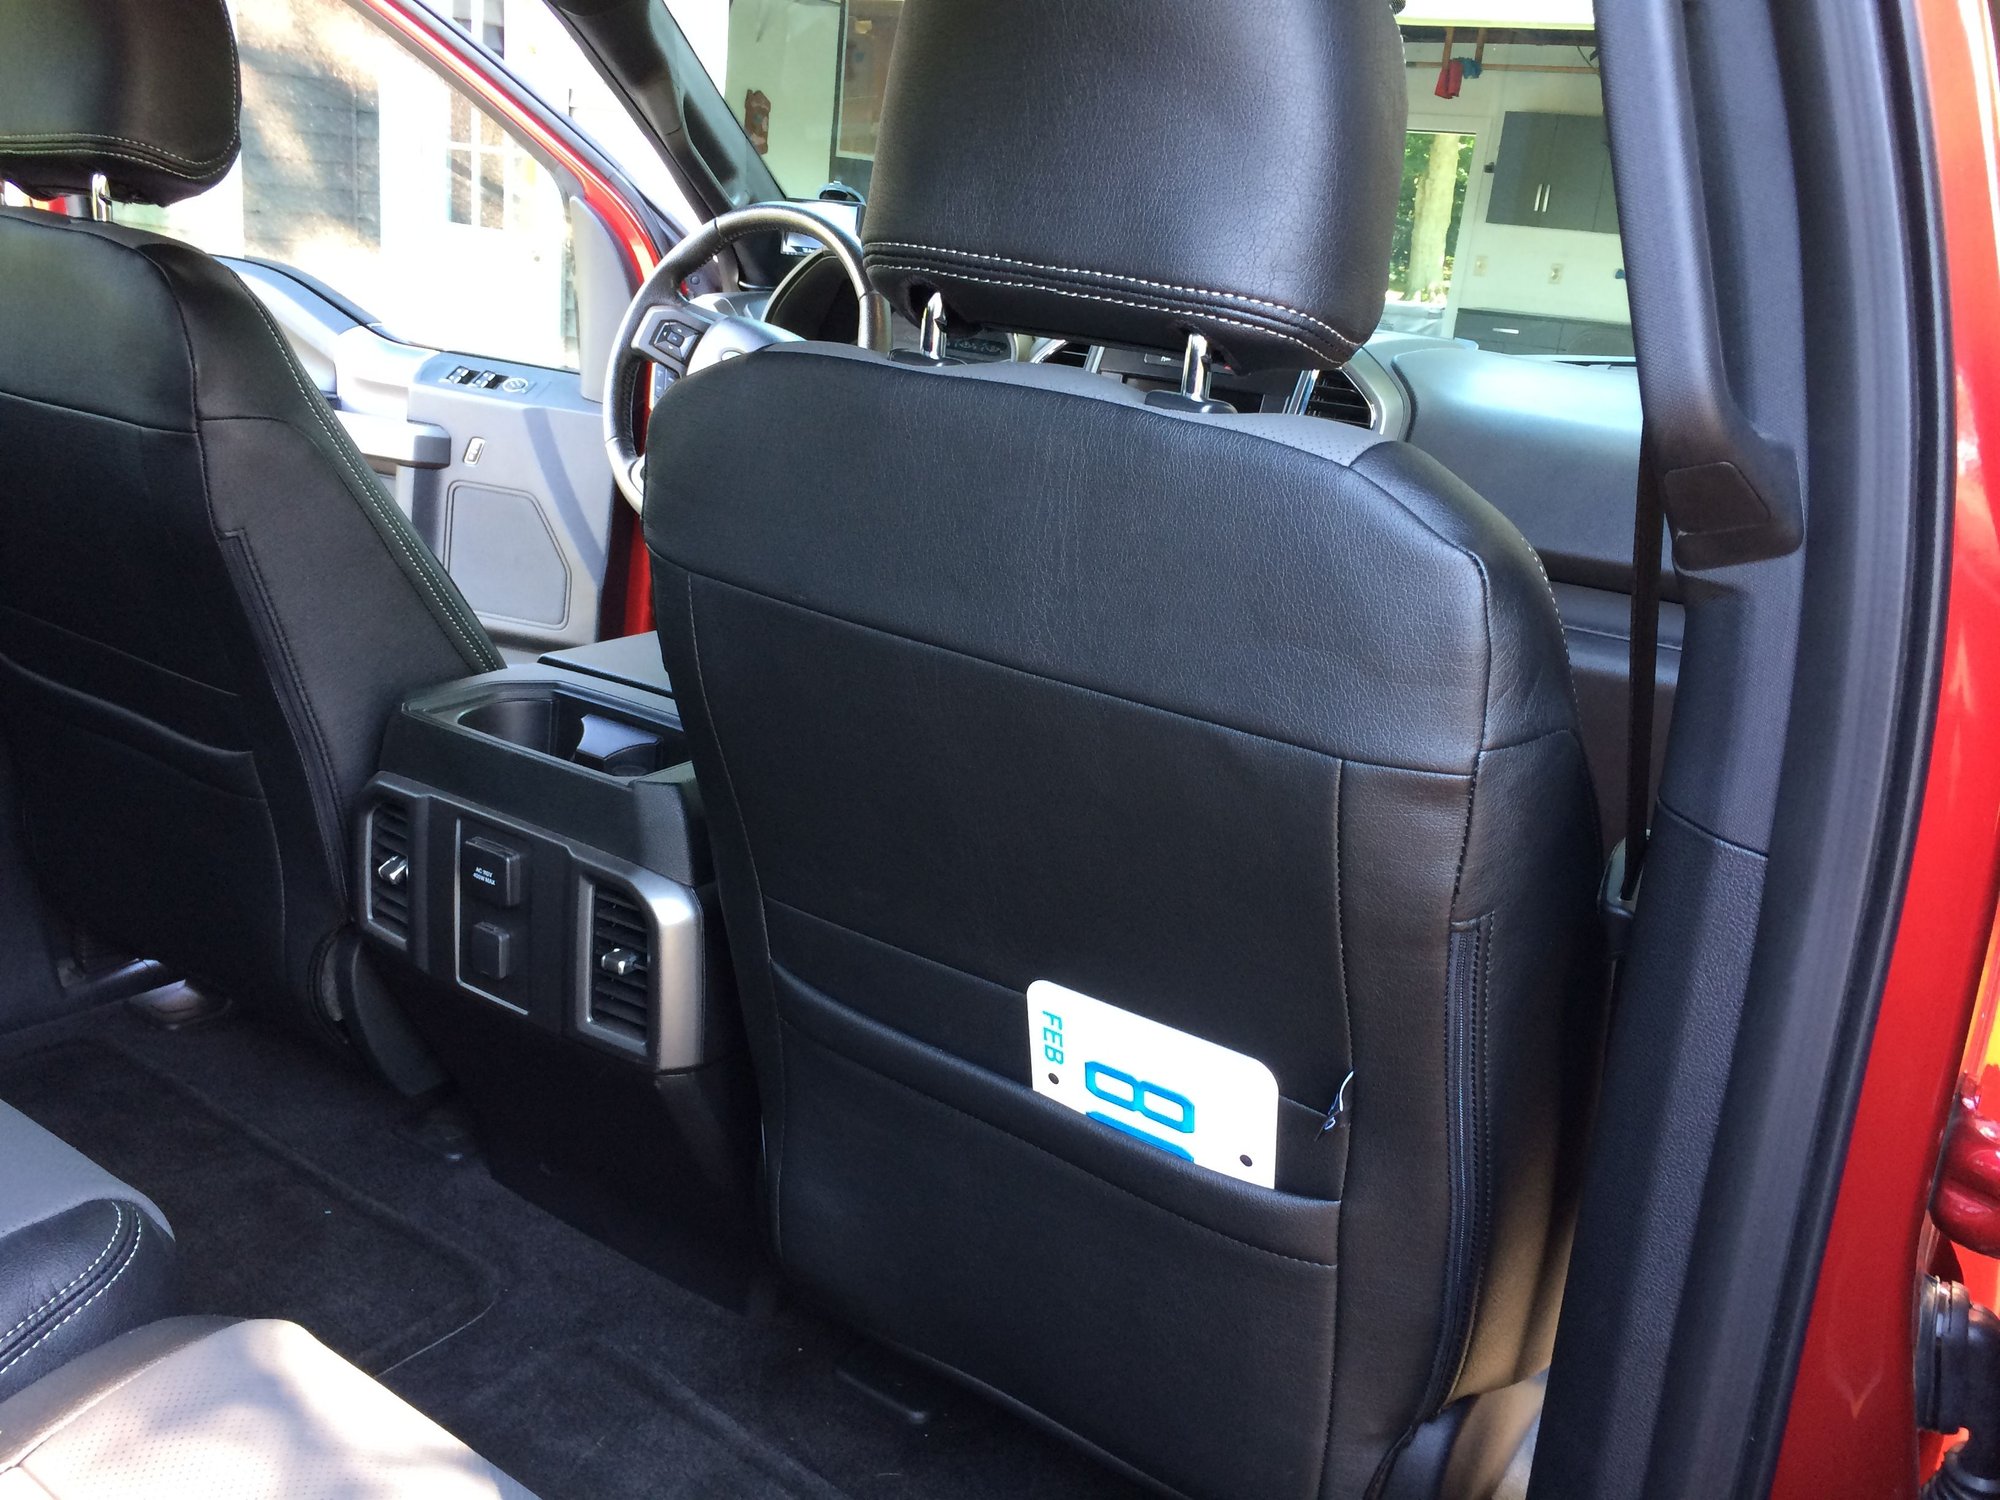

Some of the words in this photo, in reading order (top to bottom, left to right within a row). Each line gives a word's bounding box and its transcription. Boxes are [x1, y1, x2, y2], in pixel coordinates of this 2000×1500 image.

[475, 866, 483, 874] AC
[484, 877, 496, 886] MAX
[1042, 1010, 1064, 1065] FEB
[1085, 1061, 1195, 1163] 8
